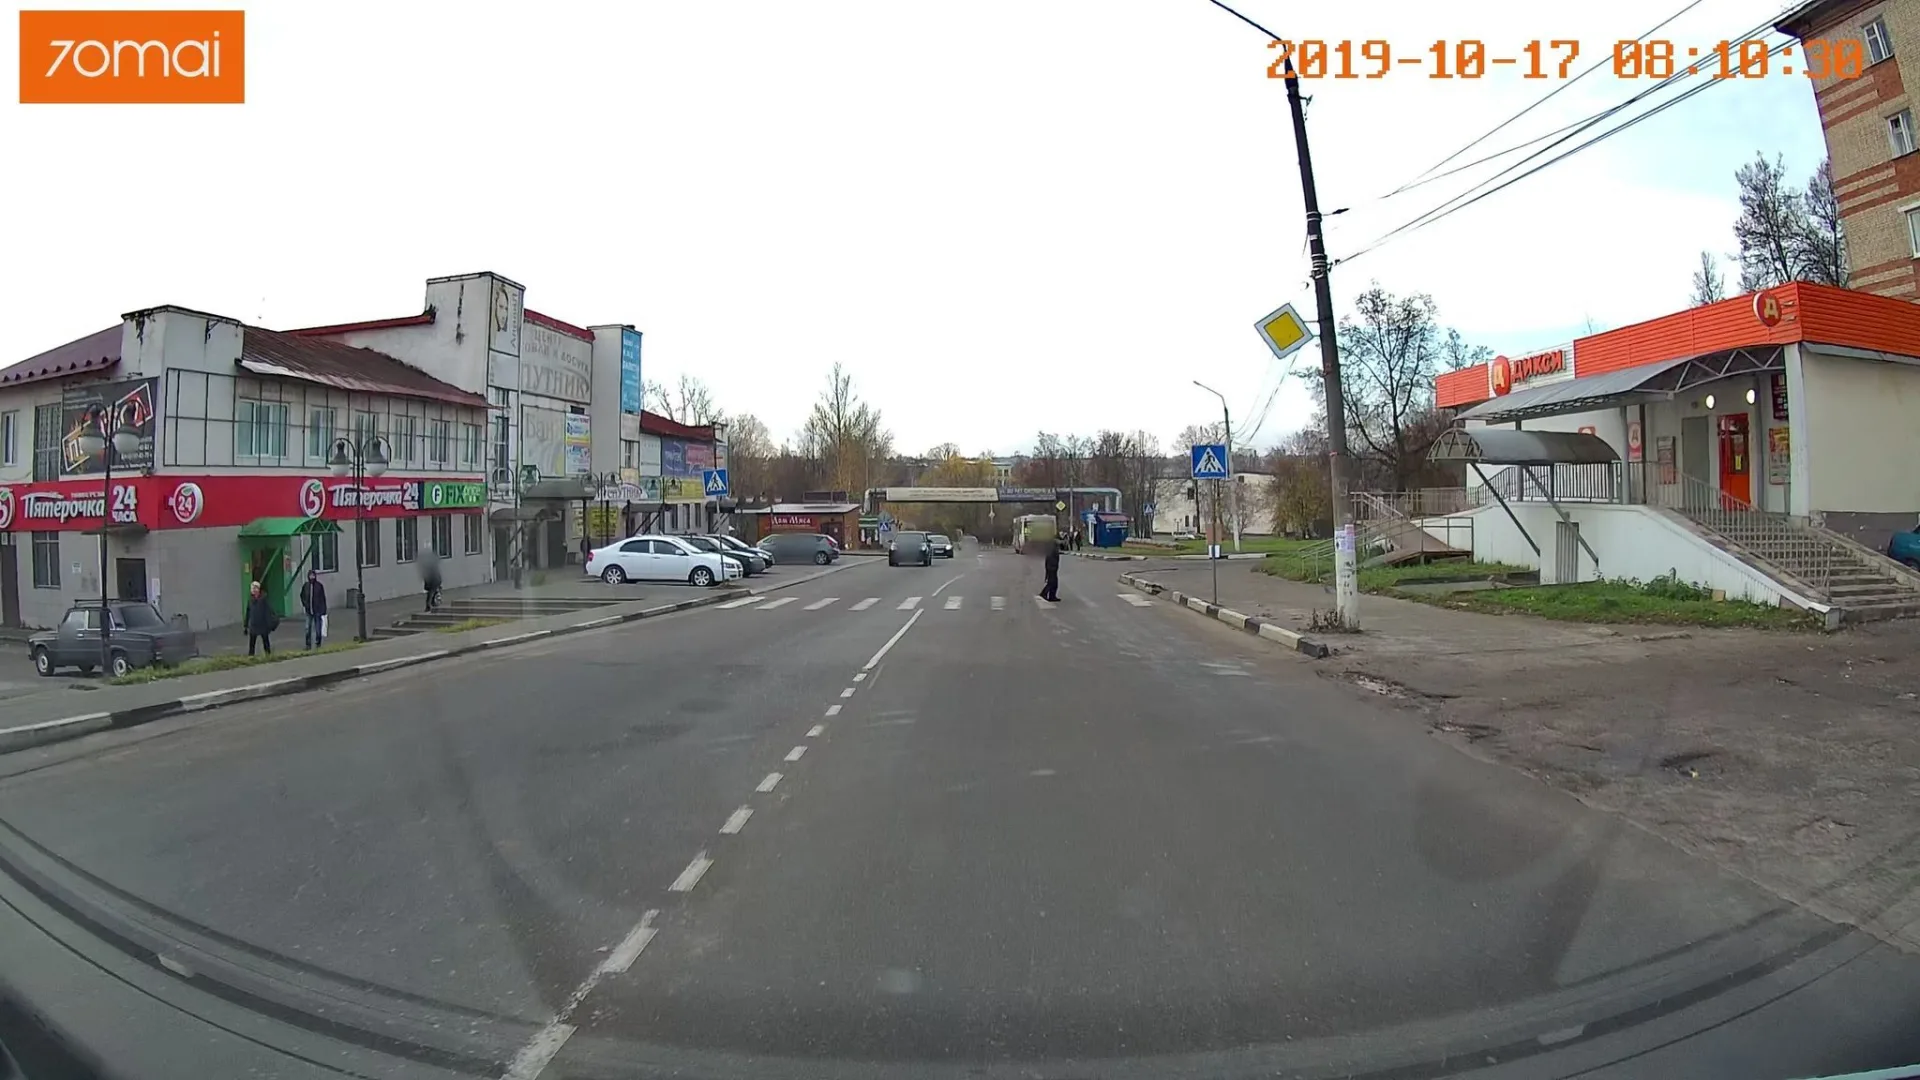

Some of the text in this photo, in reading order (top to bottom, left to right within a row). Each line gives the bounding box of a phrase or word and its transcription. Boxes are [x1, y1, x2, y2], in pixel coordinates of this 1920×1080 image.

[1511, 350, 1563, 383] ДИКСИ
[112, 485, 137, 510] 24
[403, 482, 419, 501] 24
[446, 485, 465, 504] FIX
[20, 491, 105, 523] Пятерочка
[178, 495, 192, 512] 24
